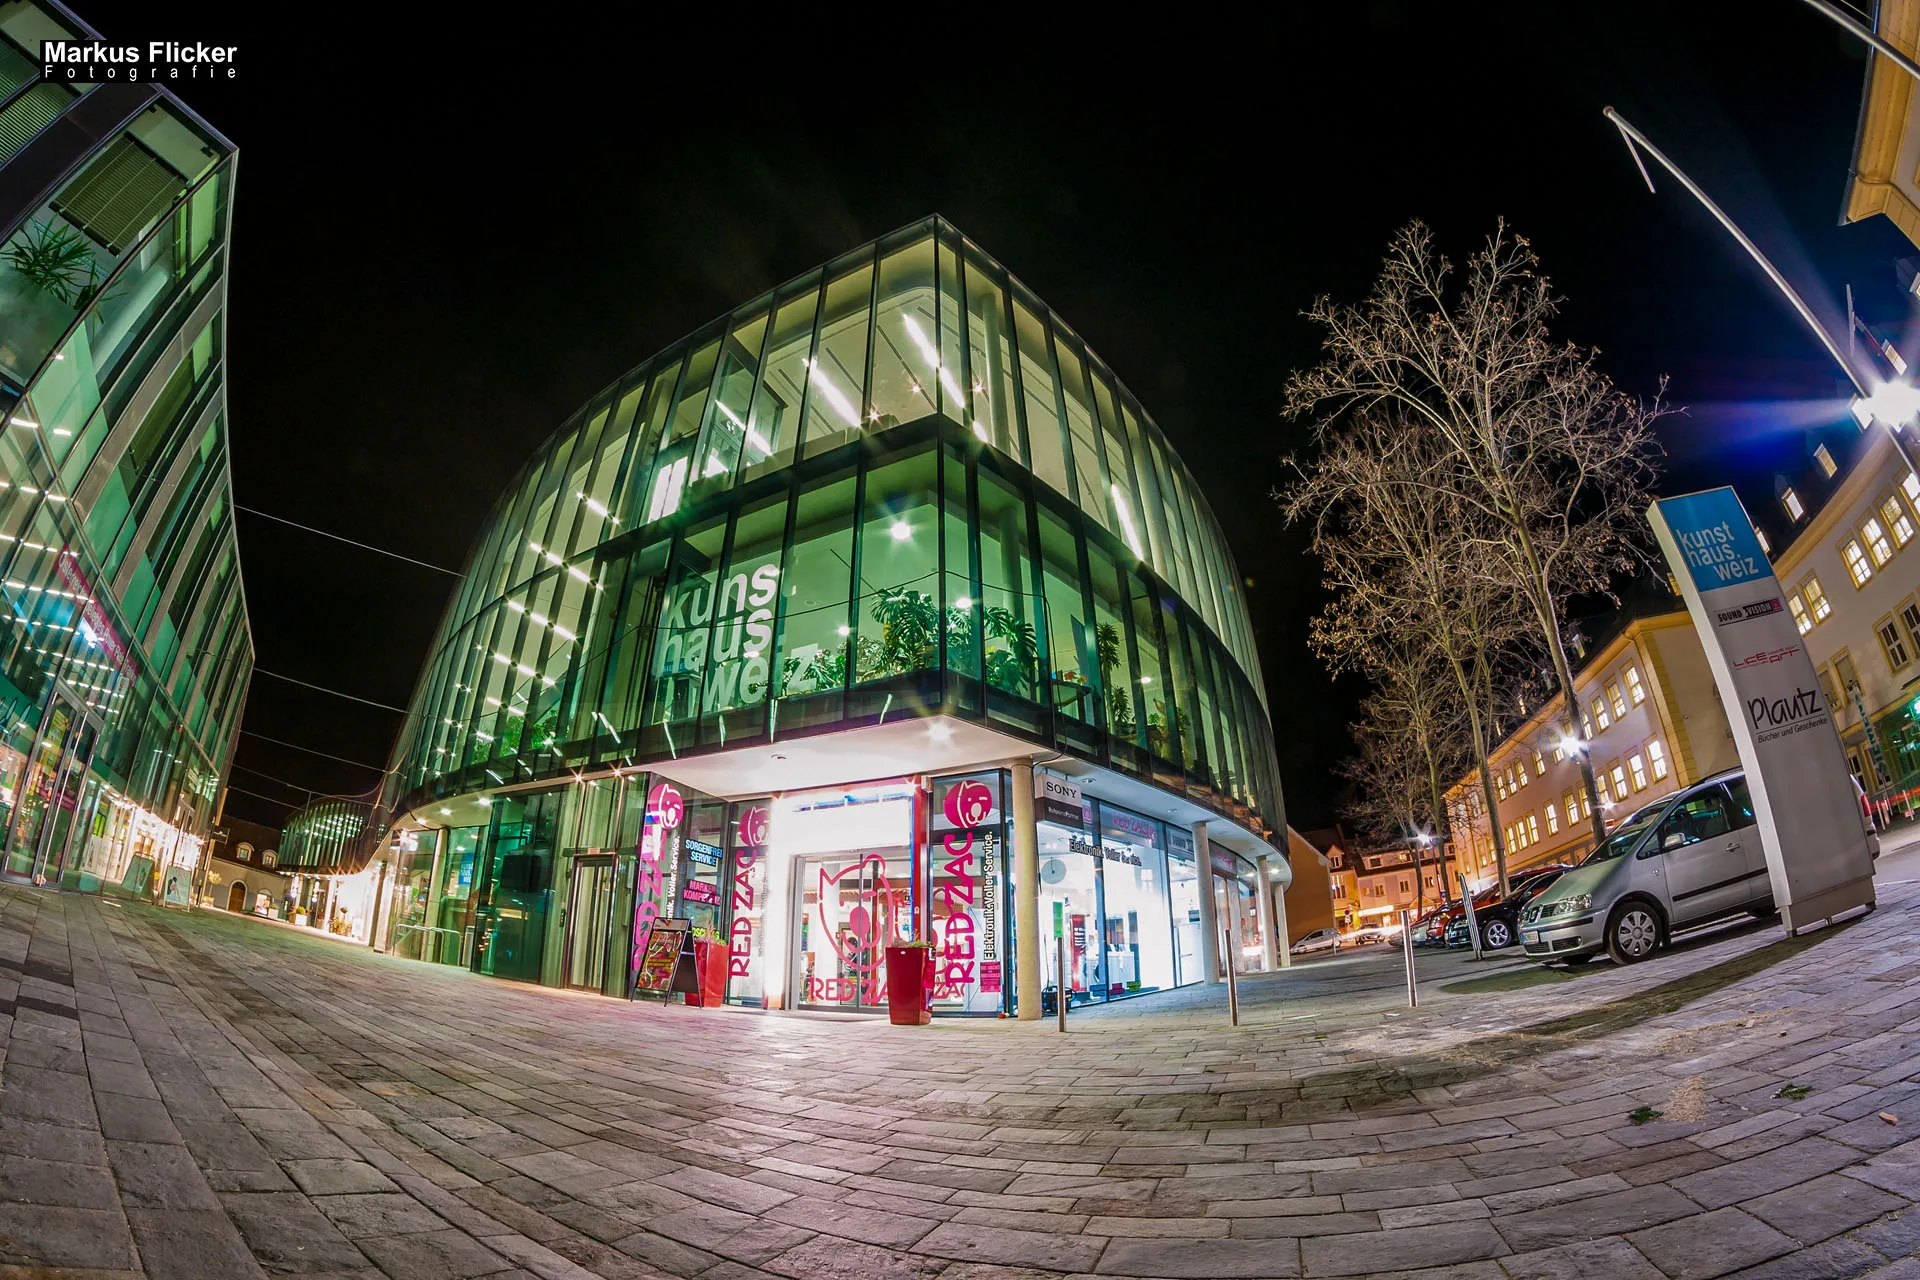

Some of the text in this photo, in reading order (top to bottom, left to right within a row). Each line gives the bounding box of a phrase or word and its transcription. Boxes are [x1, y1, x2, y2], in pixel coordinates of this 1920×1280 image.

[1676, 521, 1735, 549] kunst
[1713, 557, 1759, 581] weiz
[663, 564, 782, 631] kuns
[1718, 609, 1743, 622] SOUND
[1781, 726, 1795, 737] und
[1794, 717, 1828, 734] Geschenke
[1046, 781, 1077, 799] SONY
[685, 840, 722, 858] SORGENFREI
[690, 851, 716, 865] SERVICE
[984, 831, 994, 873] Service.
[667, 872, 676, 898] Voller
[689, 880, 716, 894] MARKEN
[984, 875, 995, 904] Voller
[728, 849, 757, 980] RED ZAC
[943, 832, 975, 988] RED ZAC
[808, 977, 856, 1003] RED
